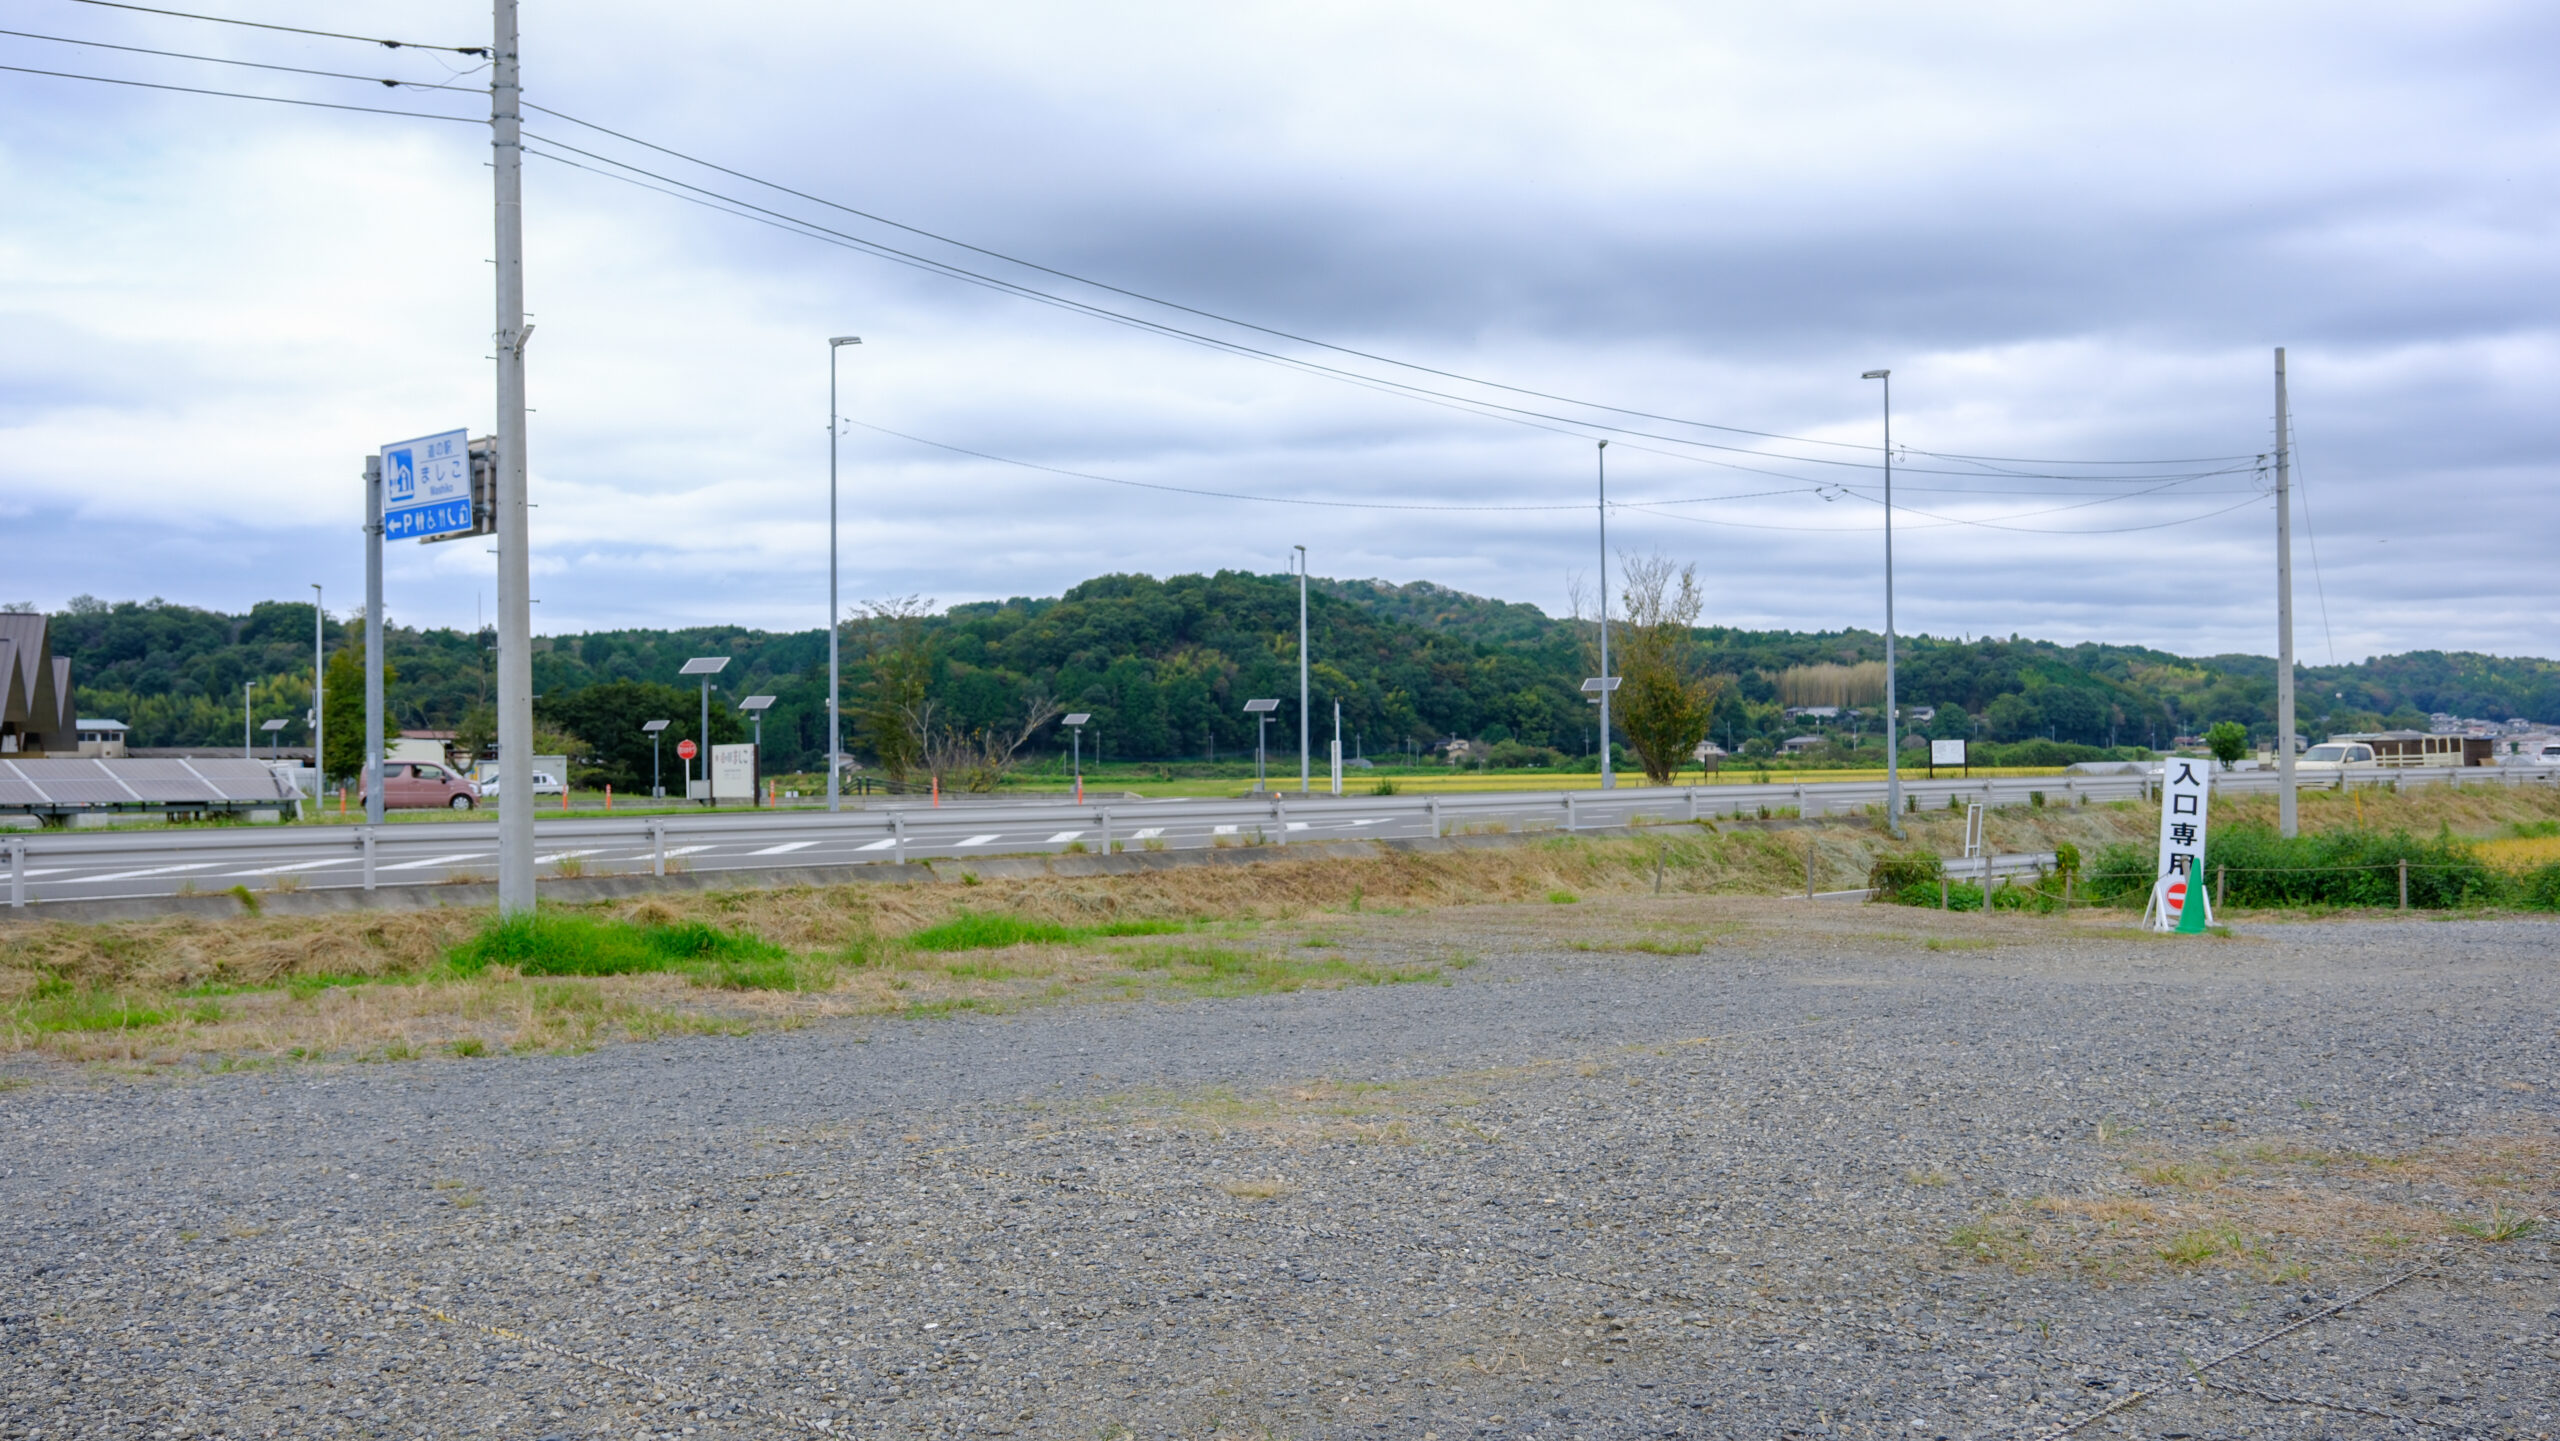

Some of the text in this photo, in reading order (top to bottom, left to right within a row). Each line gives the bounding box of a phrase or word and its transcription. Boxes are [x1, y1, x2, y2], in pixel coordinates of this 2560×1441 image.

[421, 460, 461, 484] ましこ
[403, 514, 412, 533] P
[2169, 763, 2200, 876] 入口専用
